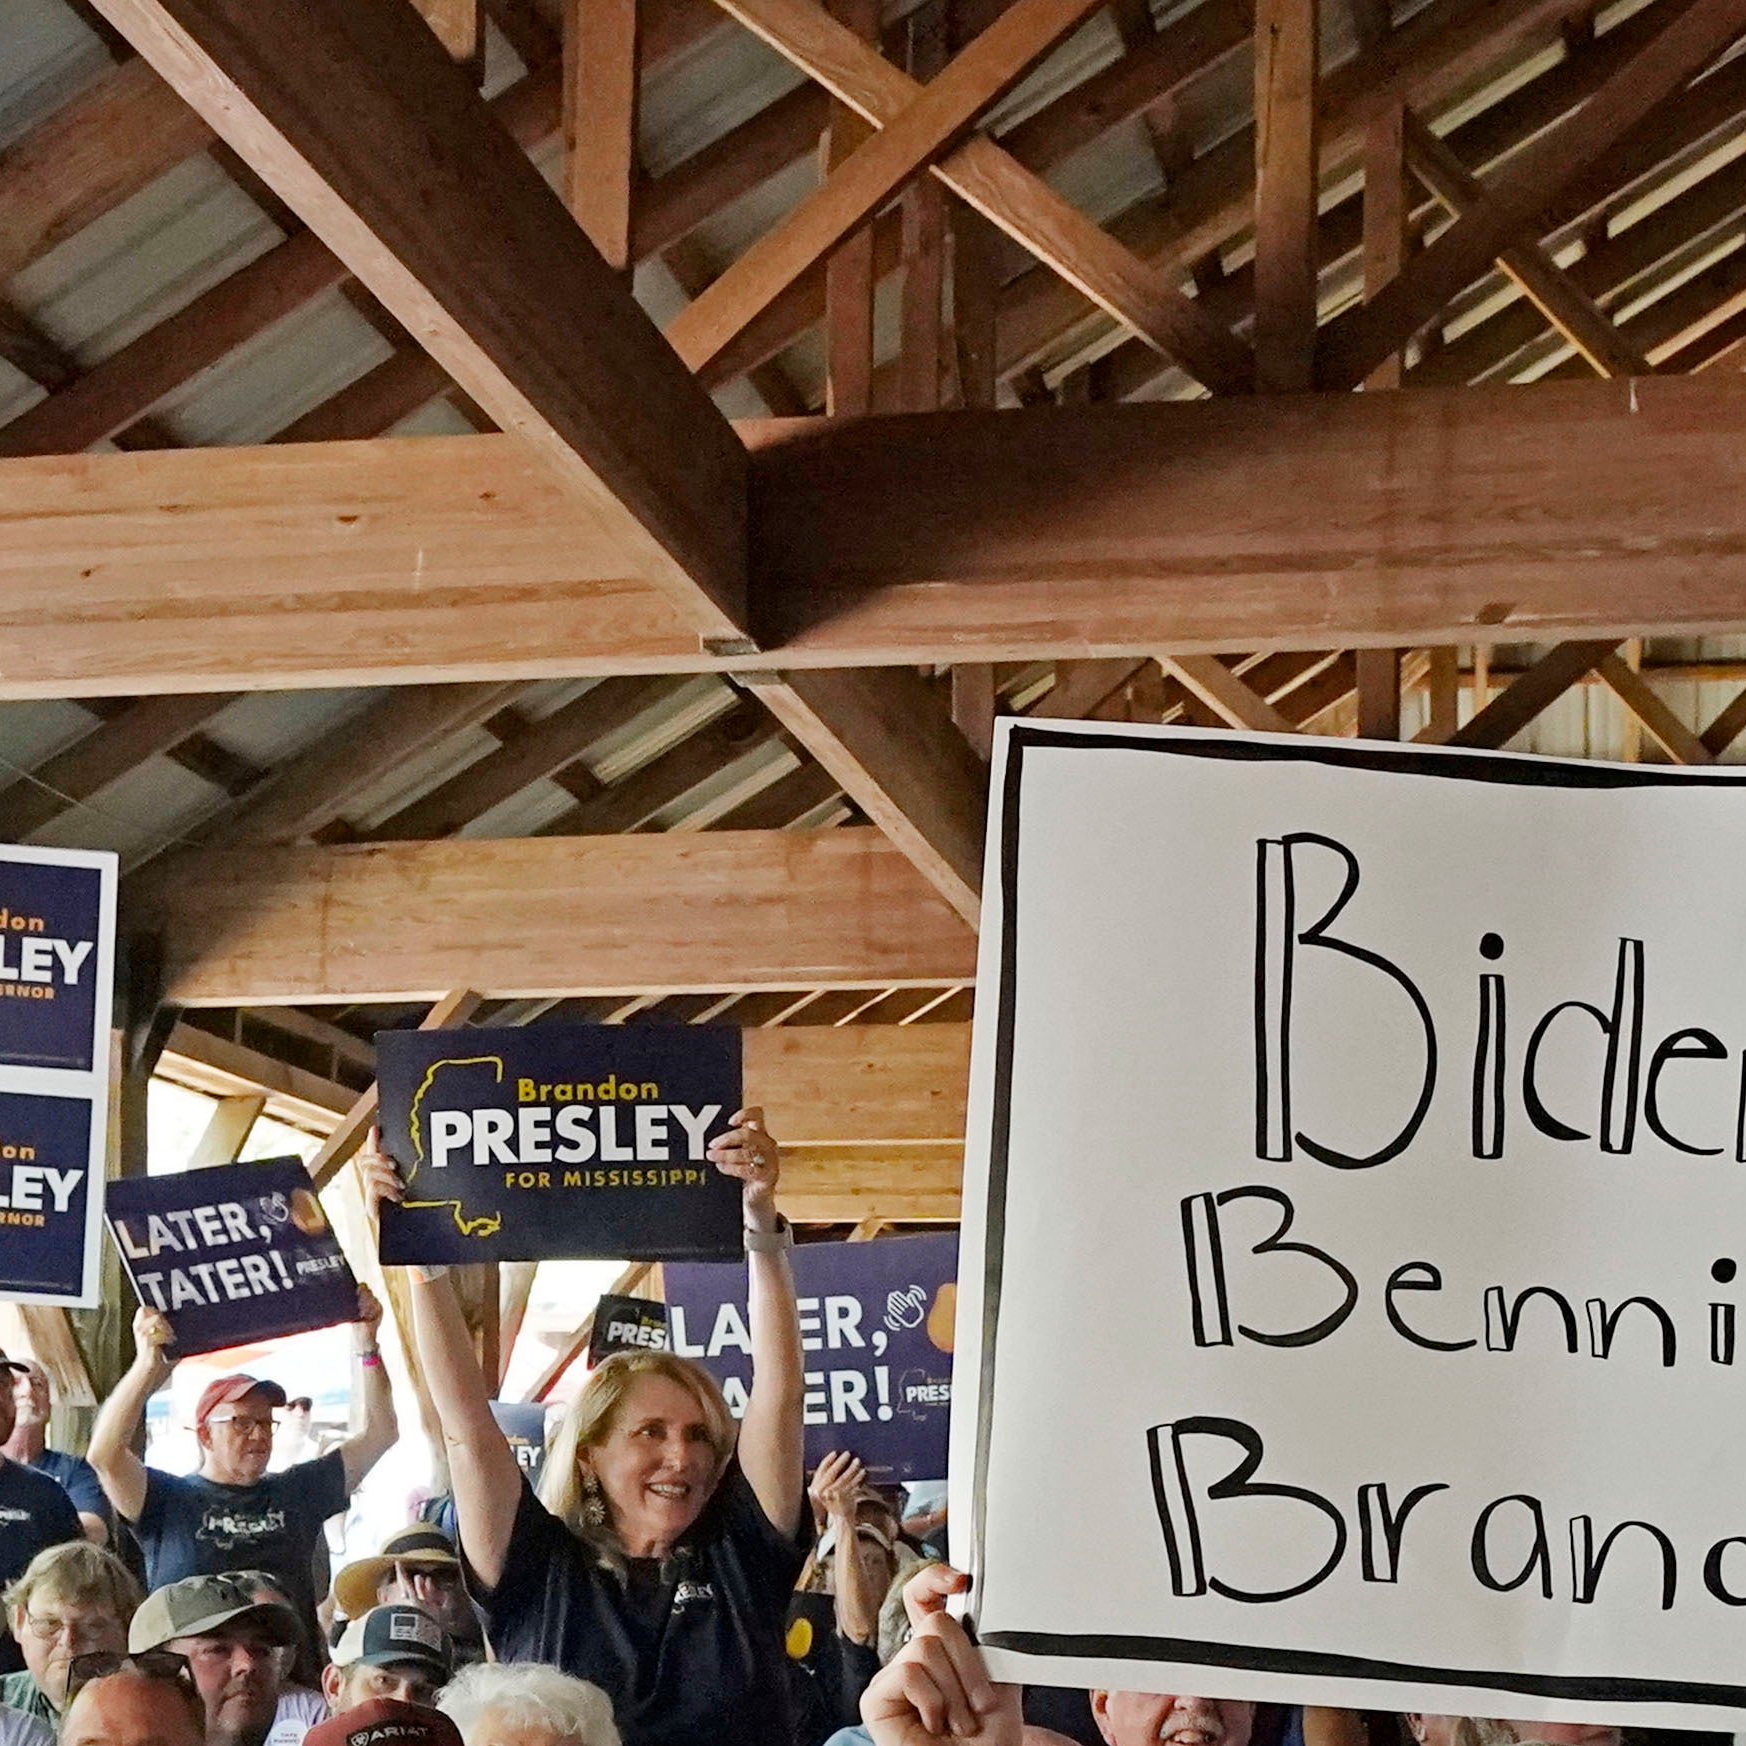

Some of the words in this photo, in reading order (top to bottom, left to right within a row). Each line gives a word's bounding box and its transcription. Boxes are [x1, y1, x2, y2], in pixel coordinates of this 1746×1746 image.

[517, 1074, 659, 1102] Brandon
[430, 1104, 722, 1168] PRESLEY
[505, 1172, 551, 1189] FOR
[563, 1169, 705, 1188] MISSISSIPPI
[114, 1202, 272, 1260] LATER,
[137, 1250, 294, 1312] TATER!
[671, 1295, 888, 1357] LAER,
[722, 1366, 893, 1425] AER!
[906, 1385, 951, 1403] PRES
[371, 1726, 429, 1743] ARIAT
